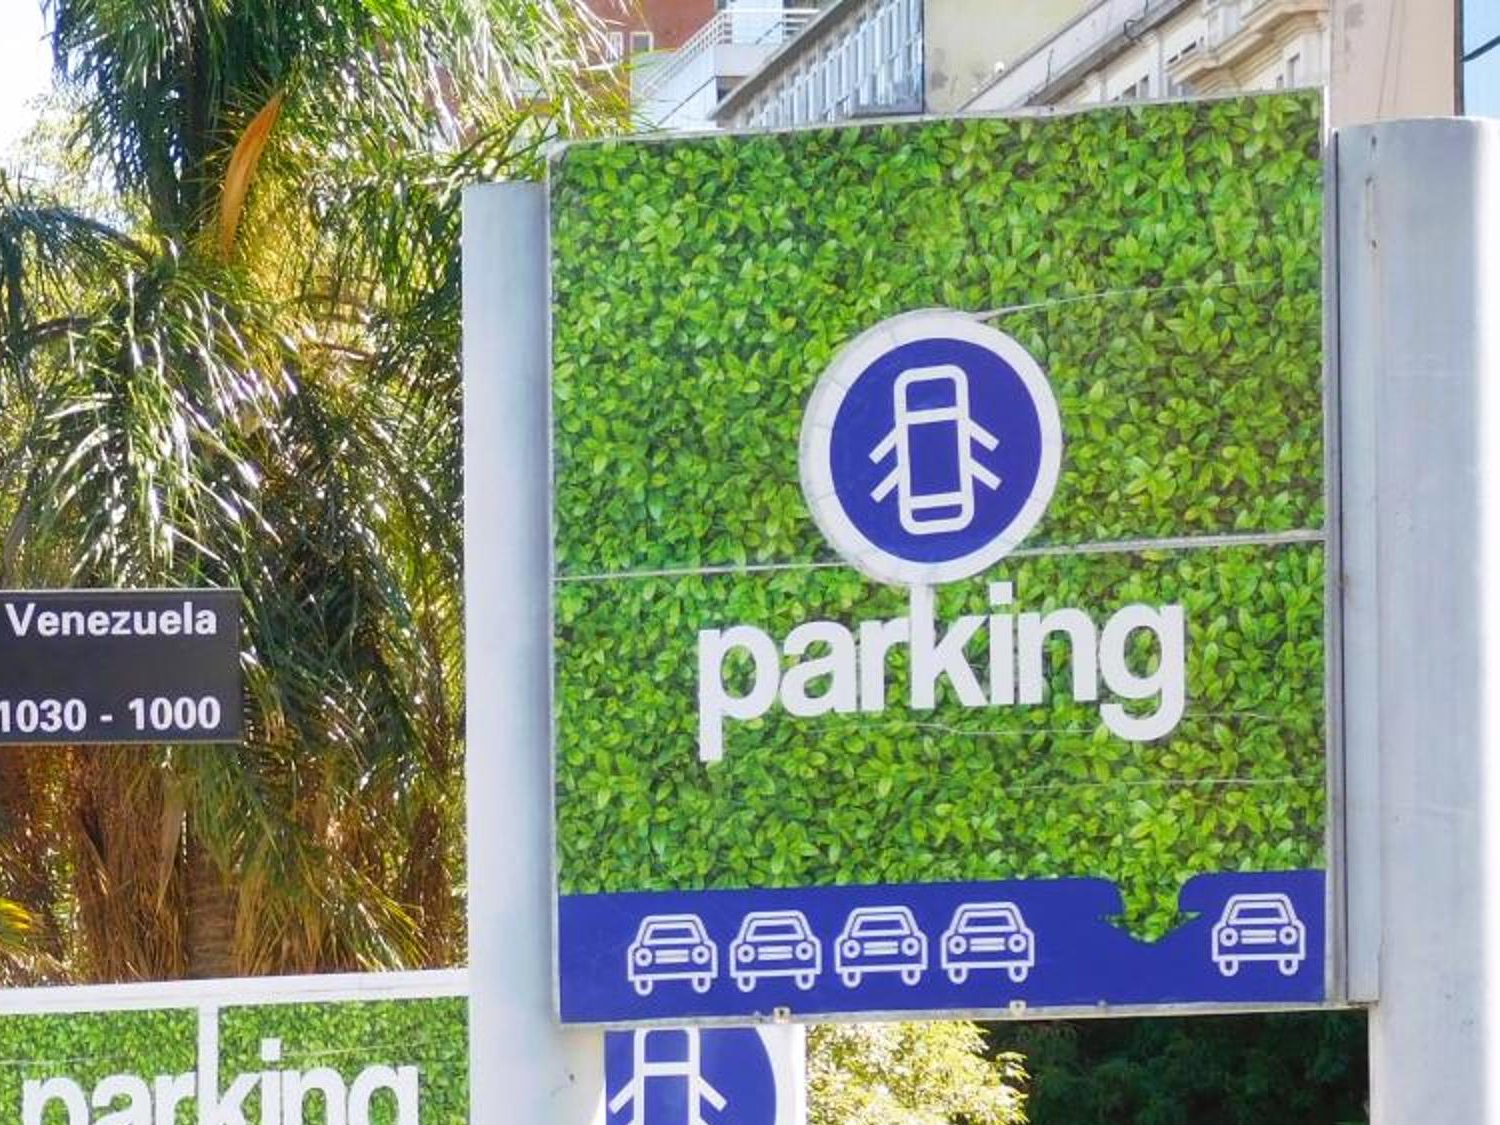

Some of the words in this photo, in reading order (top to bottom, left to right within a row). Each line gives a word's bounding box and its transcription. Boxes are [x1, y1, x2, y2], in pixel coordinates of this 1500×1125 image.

[5, 601, 218, 637] Venezuela
[695, 583, 1187, 763] parking
[128, 695, 221, 731] 1000
